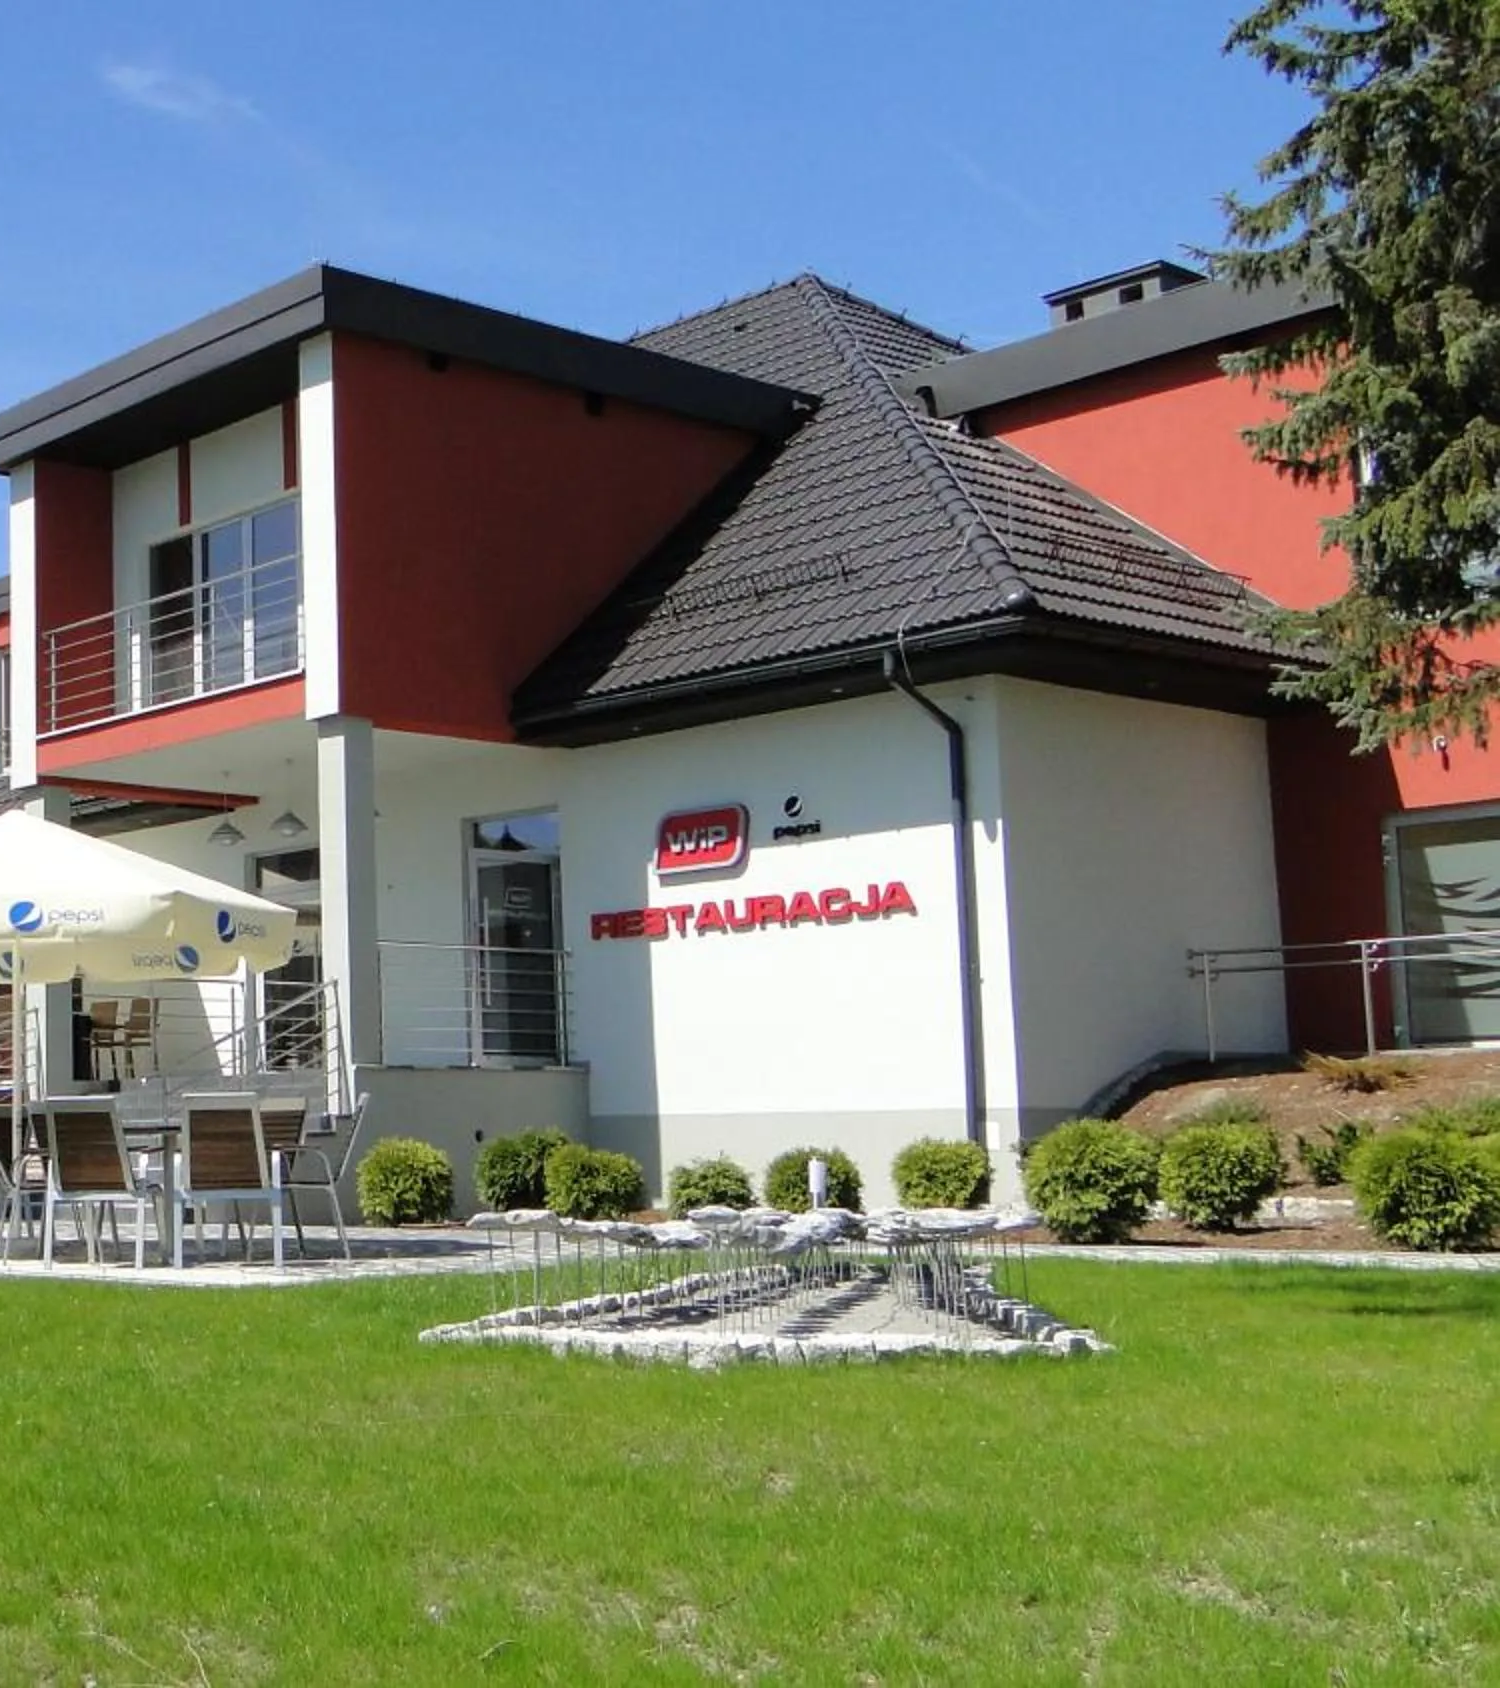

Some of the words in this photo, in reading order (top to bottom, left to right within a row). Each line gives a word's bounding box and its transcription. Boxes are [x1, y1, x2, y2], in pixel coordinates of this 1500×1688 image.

[773, 820, 820, 840] pepsi
[48, 907, 103, 924] pepsi
[591, 881, 917, 940] RESTAURACJA
